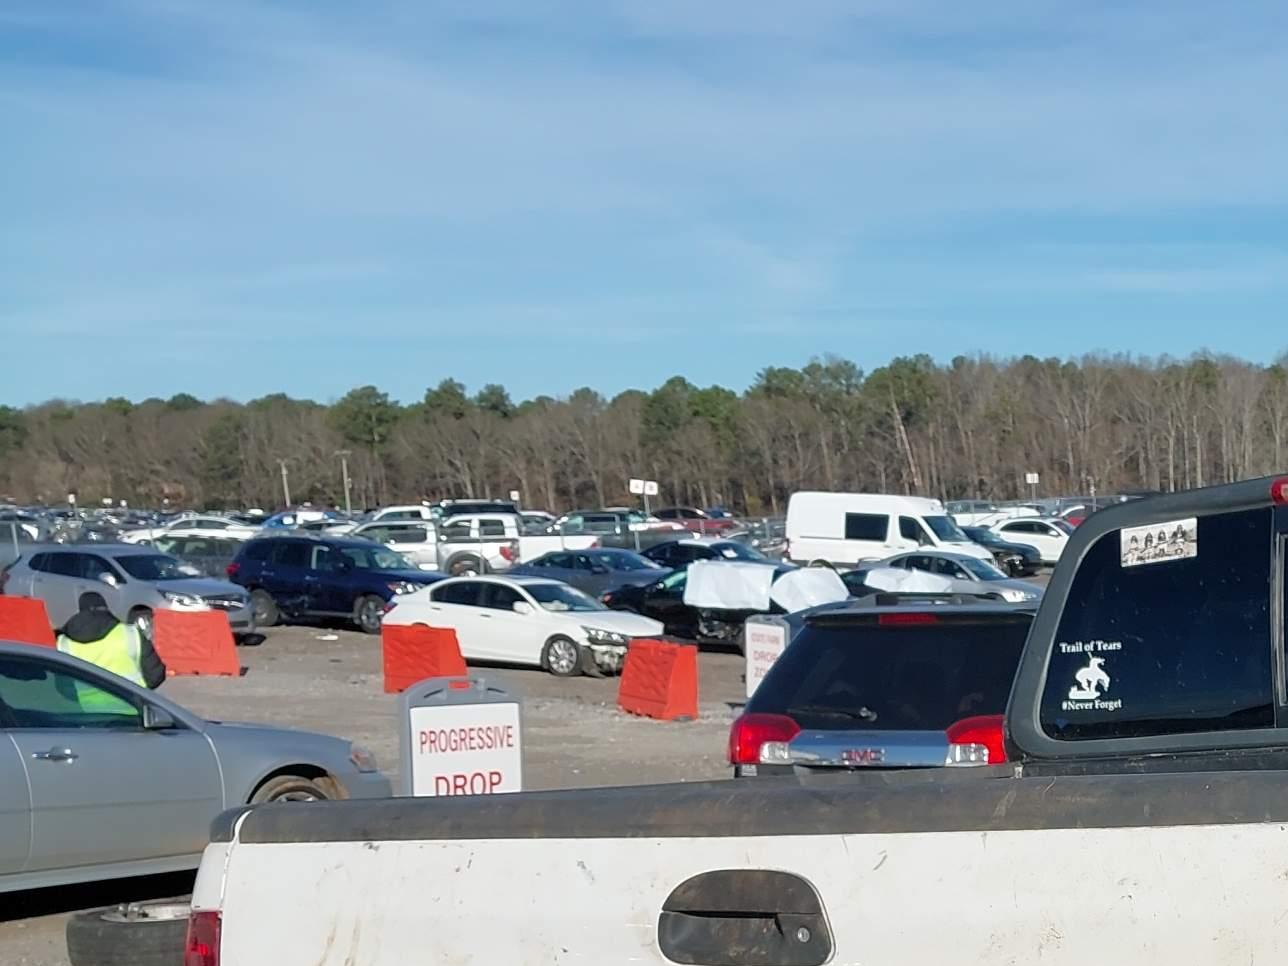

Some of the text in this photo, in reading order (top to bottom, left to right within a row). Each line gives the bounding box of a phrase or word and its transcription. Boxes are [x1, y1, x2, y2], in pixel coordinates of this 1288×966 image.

[1059, 640, 1122, 653] Trail of Tears
[1094, 699, 1122, 711] Forget
[420, 725, 514, 754] PROGRESSIVE
[435, 771, 502, 796] DROP
